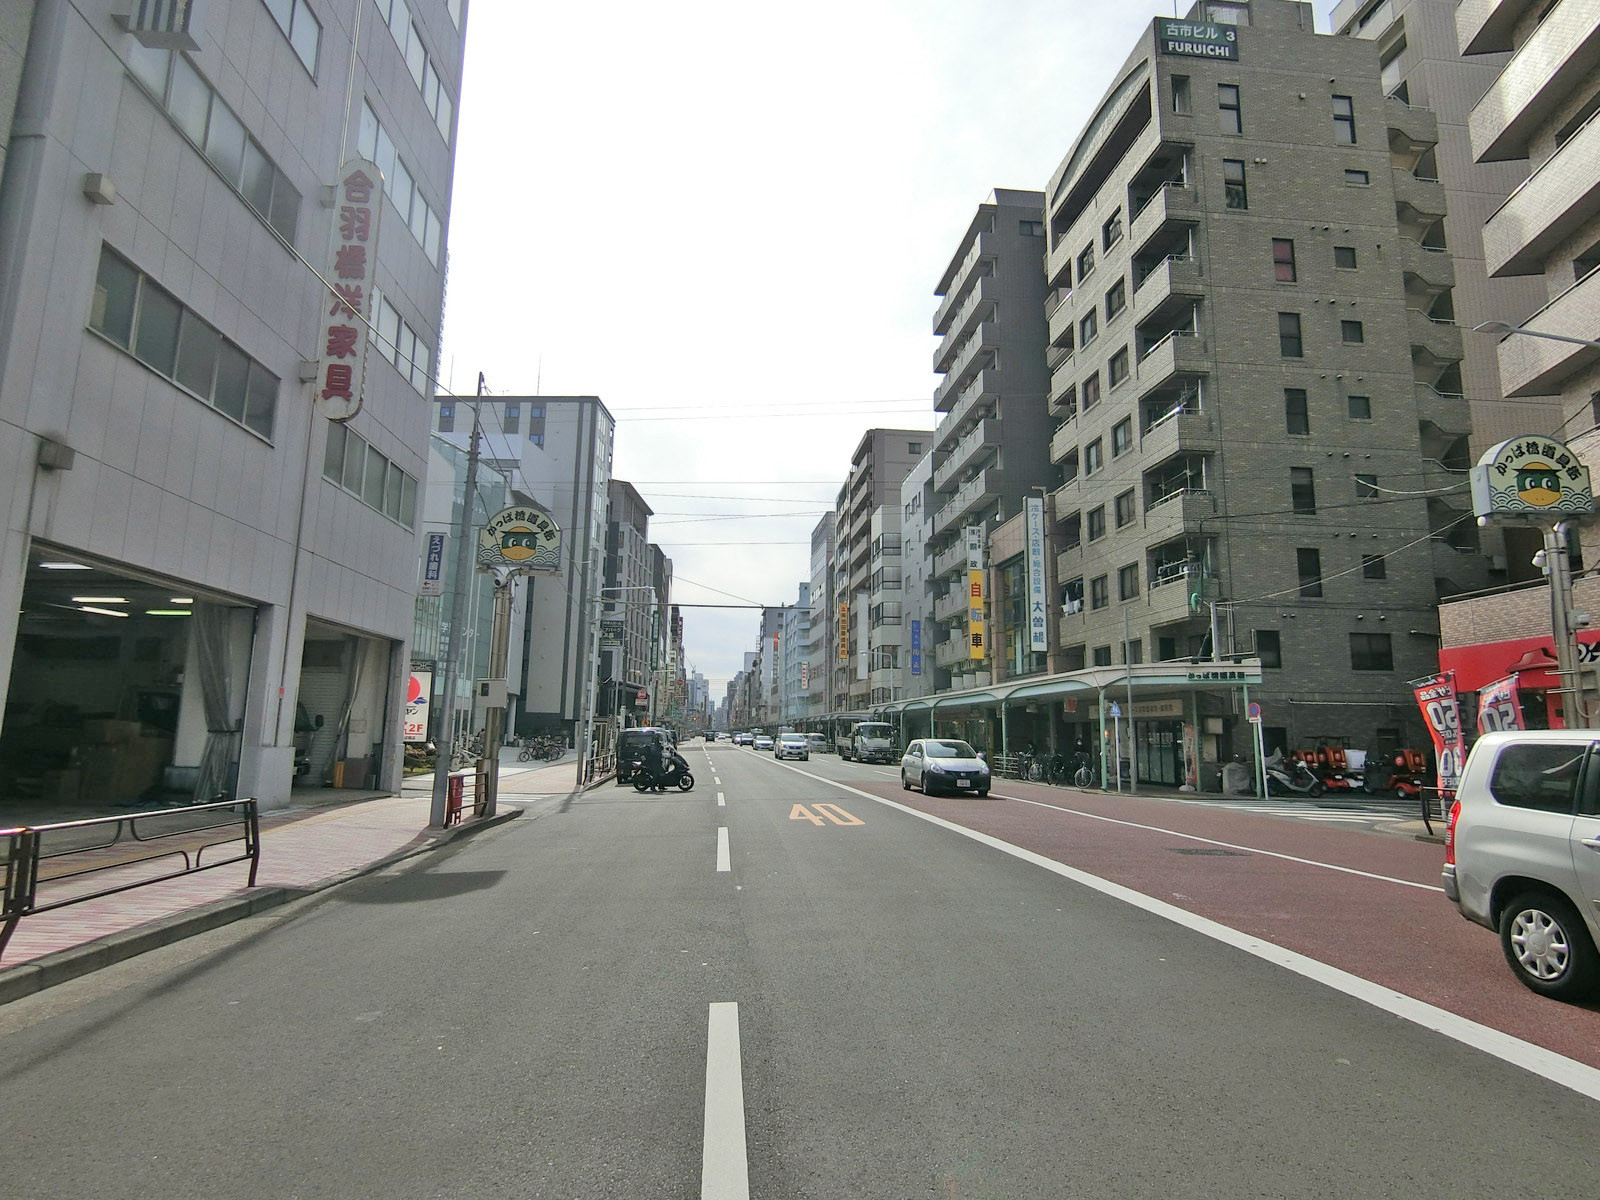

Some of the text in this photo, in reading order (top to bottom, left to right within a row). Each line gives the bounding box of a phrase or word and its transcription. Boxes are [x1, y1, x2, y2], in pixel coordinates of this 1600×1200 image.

[1166, 23, 1236, 42] 古市ビル 3
[1168, 41, 1230, 57] FURUICHI
[321, 169, 375, 402] 合羽橋洋家具
[971, 582, 983, 648] 自転車
[408, 723, 424, 732] 2F
[789, 803, 866, 826] 40
